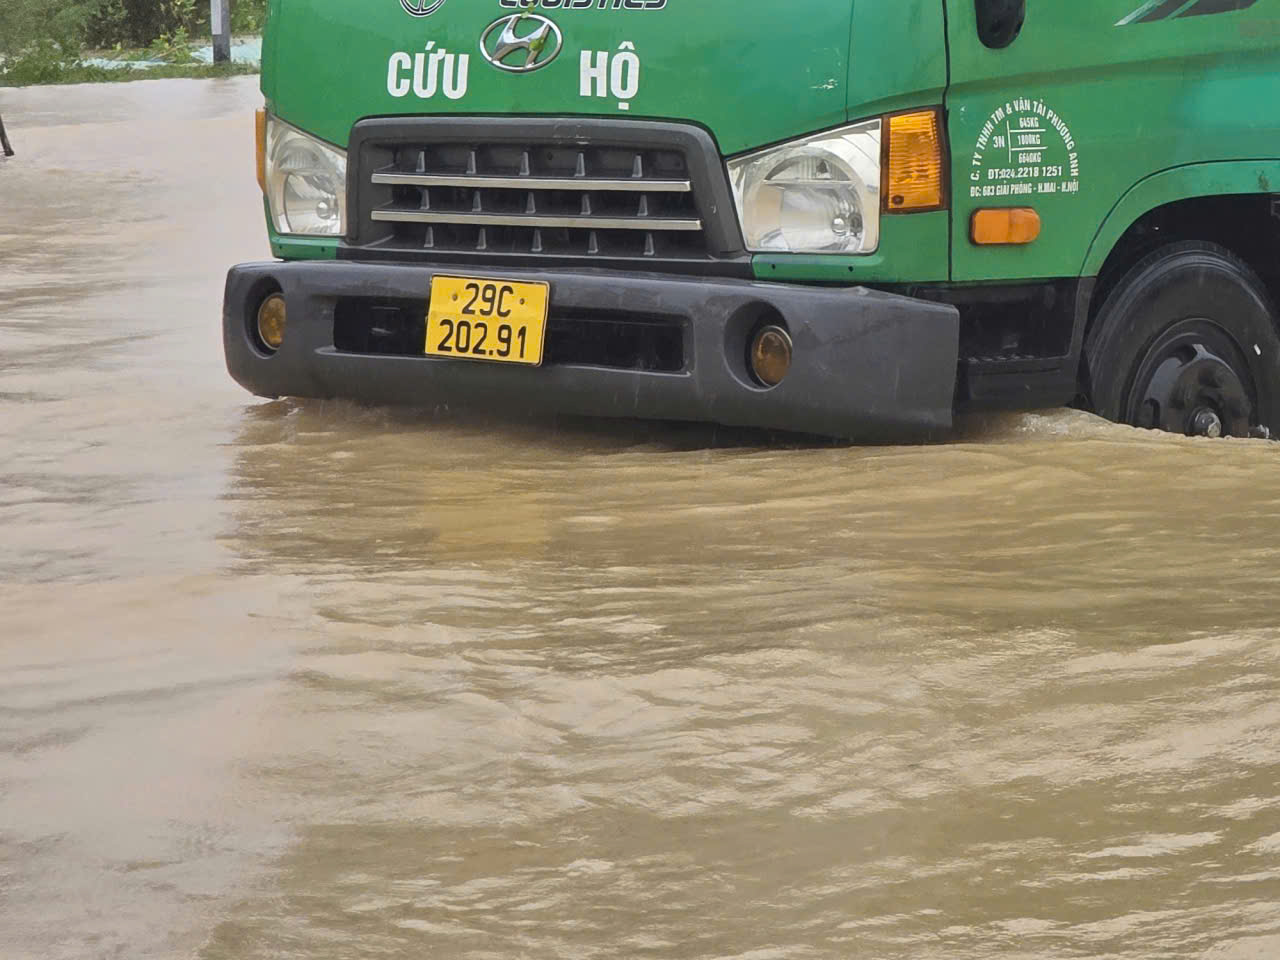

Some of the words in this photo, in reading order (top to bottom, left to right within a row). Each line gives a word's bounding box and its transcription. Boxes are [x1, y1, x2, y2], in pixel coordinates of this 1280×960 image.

[387, 40, 469, 99] CỨU
[580, 41, 640, 110] HỘ
[976, 120, 995, 150] TNHH
[991, 107, 1005, 125] TM
[1005, 103, 1012, 115] &
[1068, 152, 1079, 176] ANH
[1042, 166, 1062, 177] 1251
[462, 282, 513, 317] 29C
[437, 319, 526, 359] 202.91
